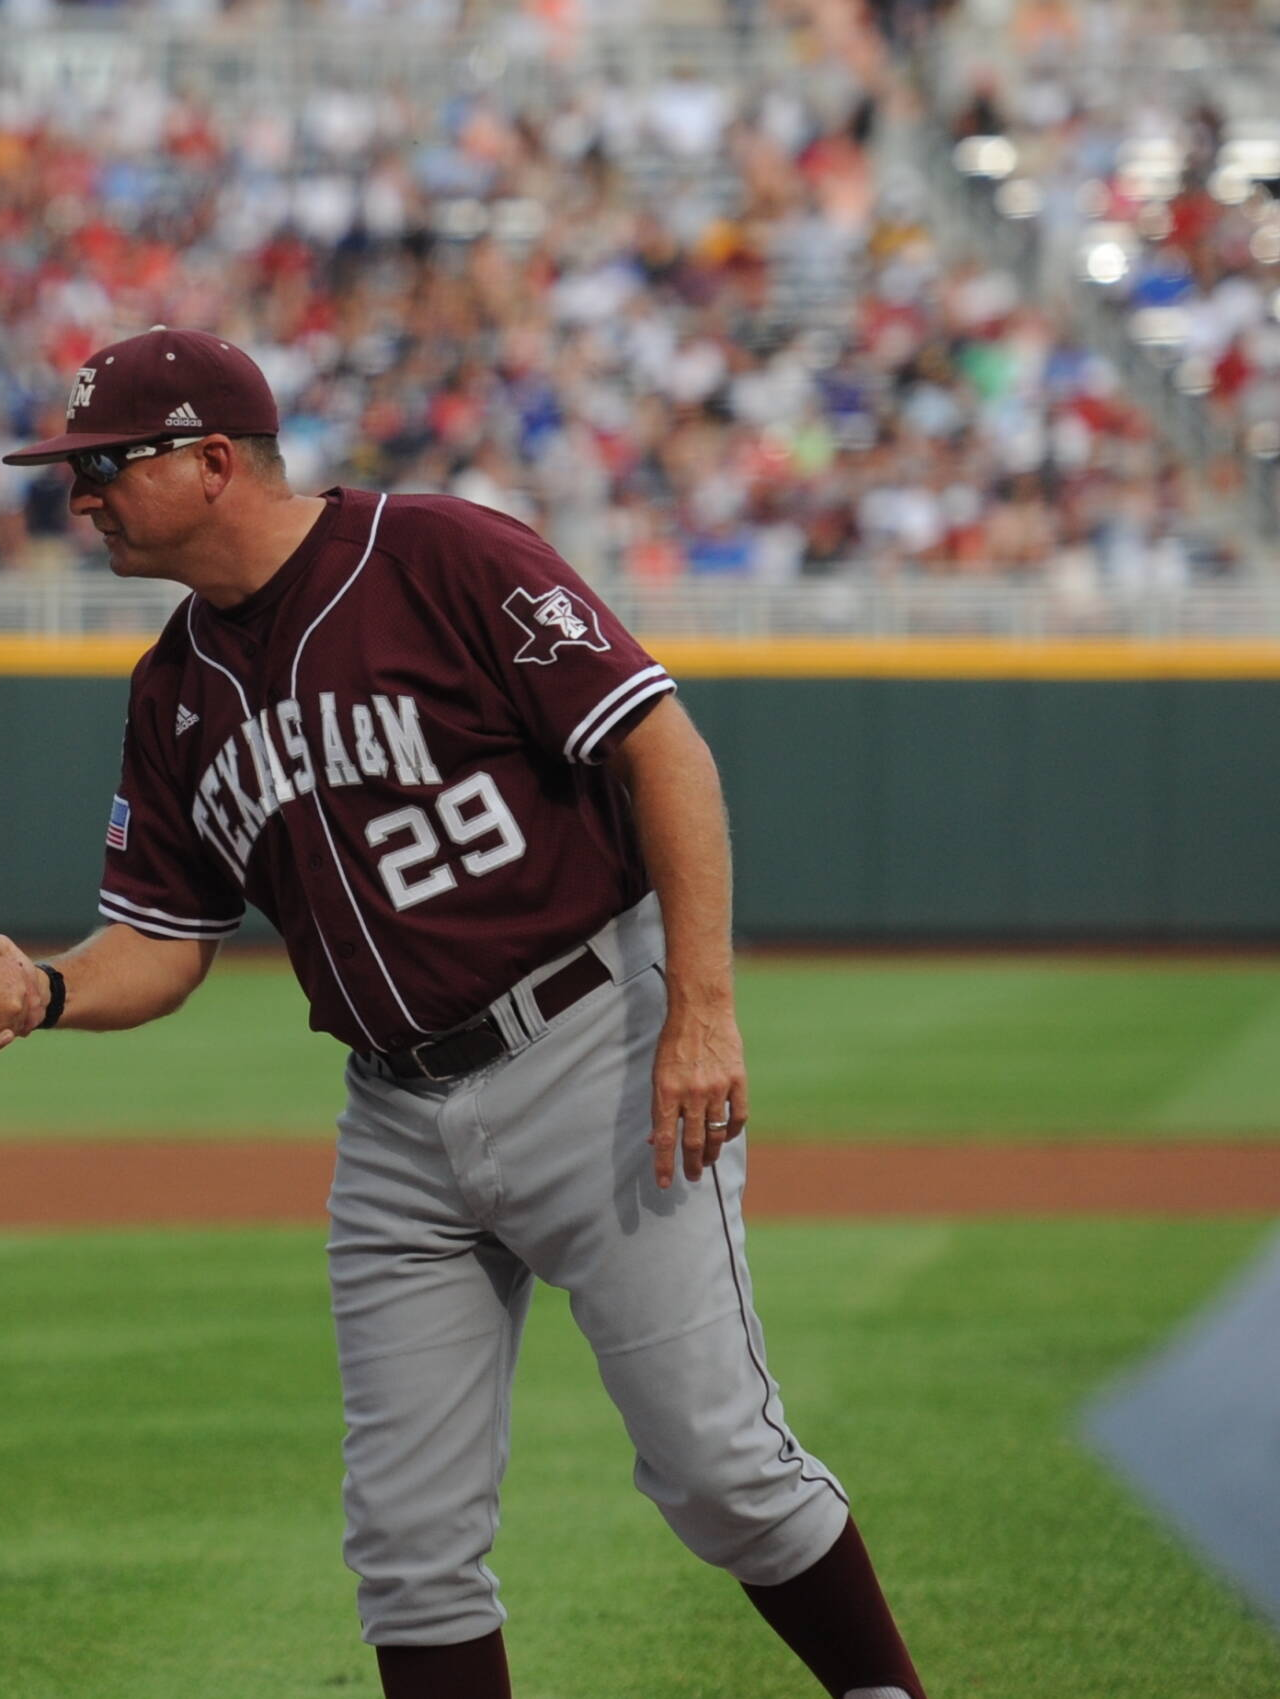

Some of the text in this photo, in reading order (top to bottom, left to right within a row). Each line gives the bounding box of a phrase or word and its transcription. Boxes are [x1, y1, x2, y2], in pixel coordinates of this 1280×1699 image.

[165, 416, 202, 427] adidas
[192, 692, 443, 885] TEXAS A&M
[365, 771, 526, 911] 29
